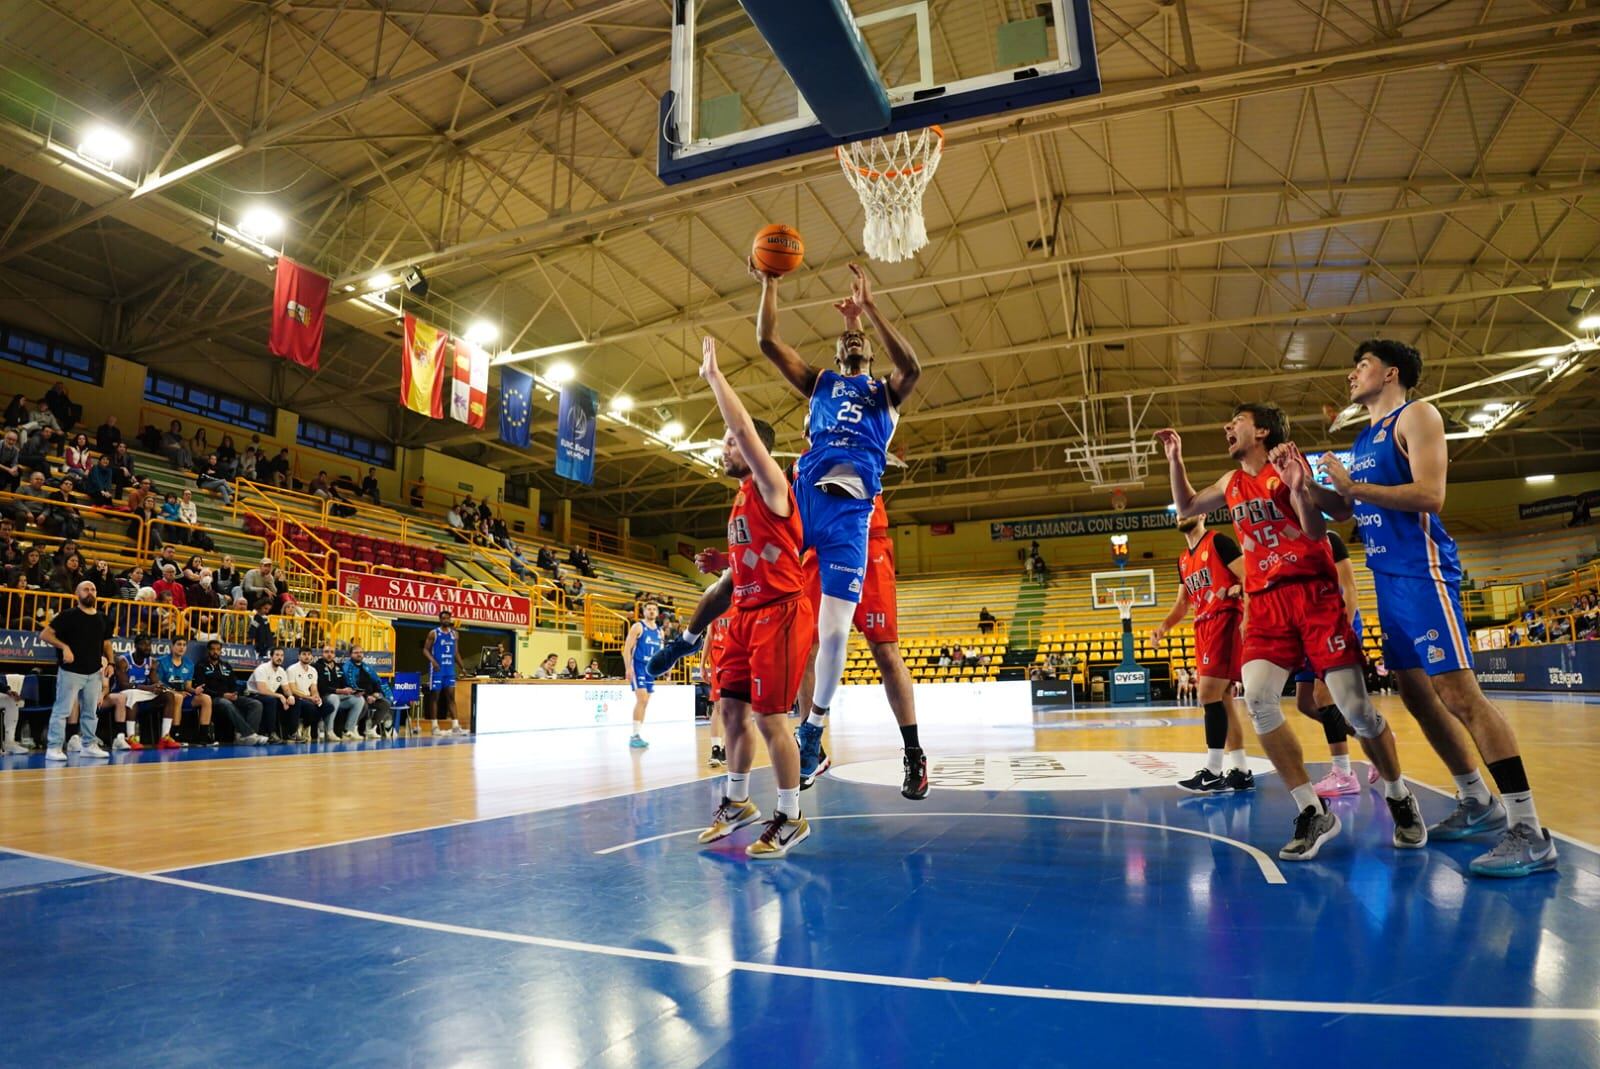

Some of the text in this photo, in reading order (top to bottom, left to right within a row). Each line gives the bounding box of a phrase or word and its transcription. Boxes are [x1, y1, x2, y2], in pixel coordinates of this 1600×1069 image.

[837, 401, 863, 423] 25
[1015, 523, 1085, 538] SALAMANCA
[1086, 518, 1114, 533] CON
[1115, 516, 1139, 530] SUS
[1142, 511, 1178, 528] REINA
[1207, 508, 1230, 523] EUR
[1253, 525, 1279, 548] 15
[388, 580, 513, 611] SALAMANCA
[364, 595, 527, 624] PATRIMONIO DE LA HUMANIDAD
[867, 613, 885, 628] 34
[20, 636, 29, 648] Y
[112, 641, 170, 655] ALANCA
[446, 645, 450, 653] 3
[1328, 635, 1346, 653] 15
[221, 647, 250, 658] STILLA
[1203, 652, 1209, 665] 6
[395, 681, 417, 691] molten
